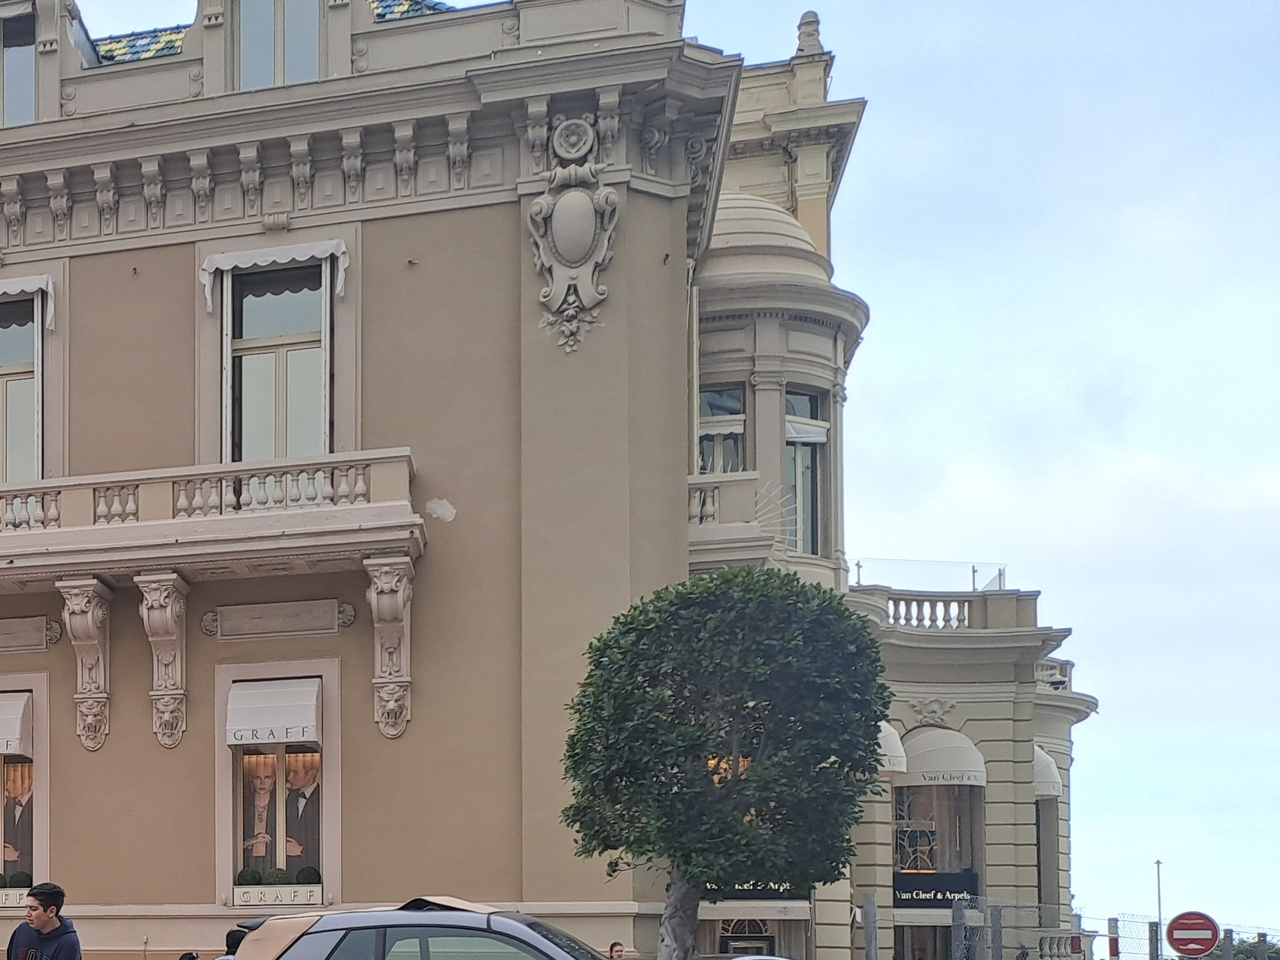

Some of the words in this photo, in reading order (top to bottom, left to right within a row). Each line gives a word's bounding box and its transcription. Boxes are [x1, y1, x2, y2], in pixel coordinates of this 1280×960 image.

[233, 726, 309, 741] GRAFF
[922, 773, 940, 782] Van
[240, 890, 314, 902] GRAFF
[896, 891, 911, 899] Van
[913, 890, 935, 899] Cleef
[945, 891, 970, 901] Arpels
